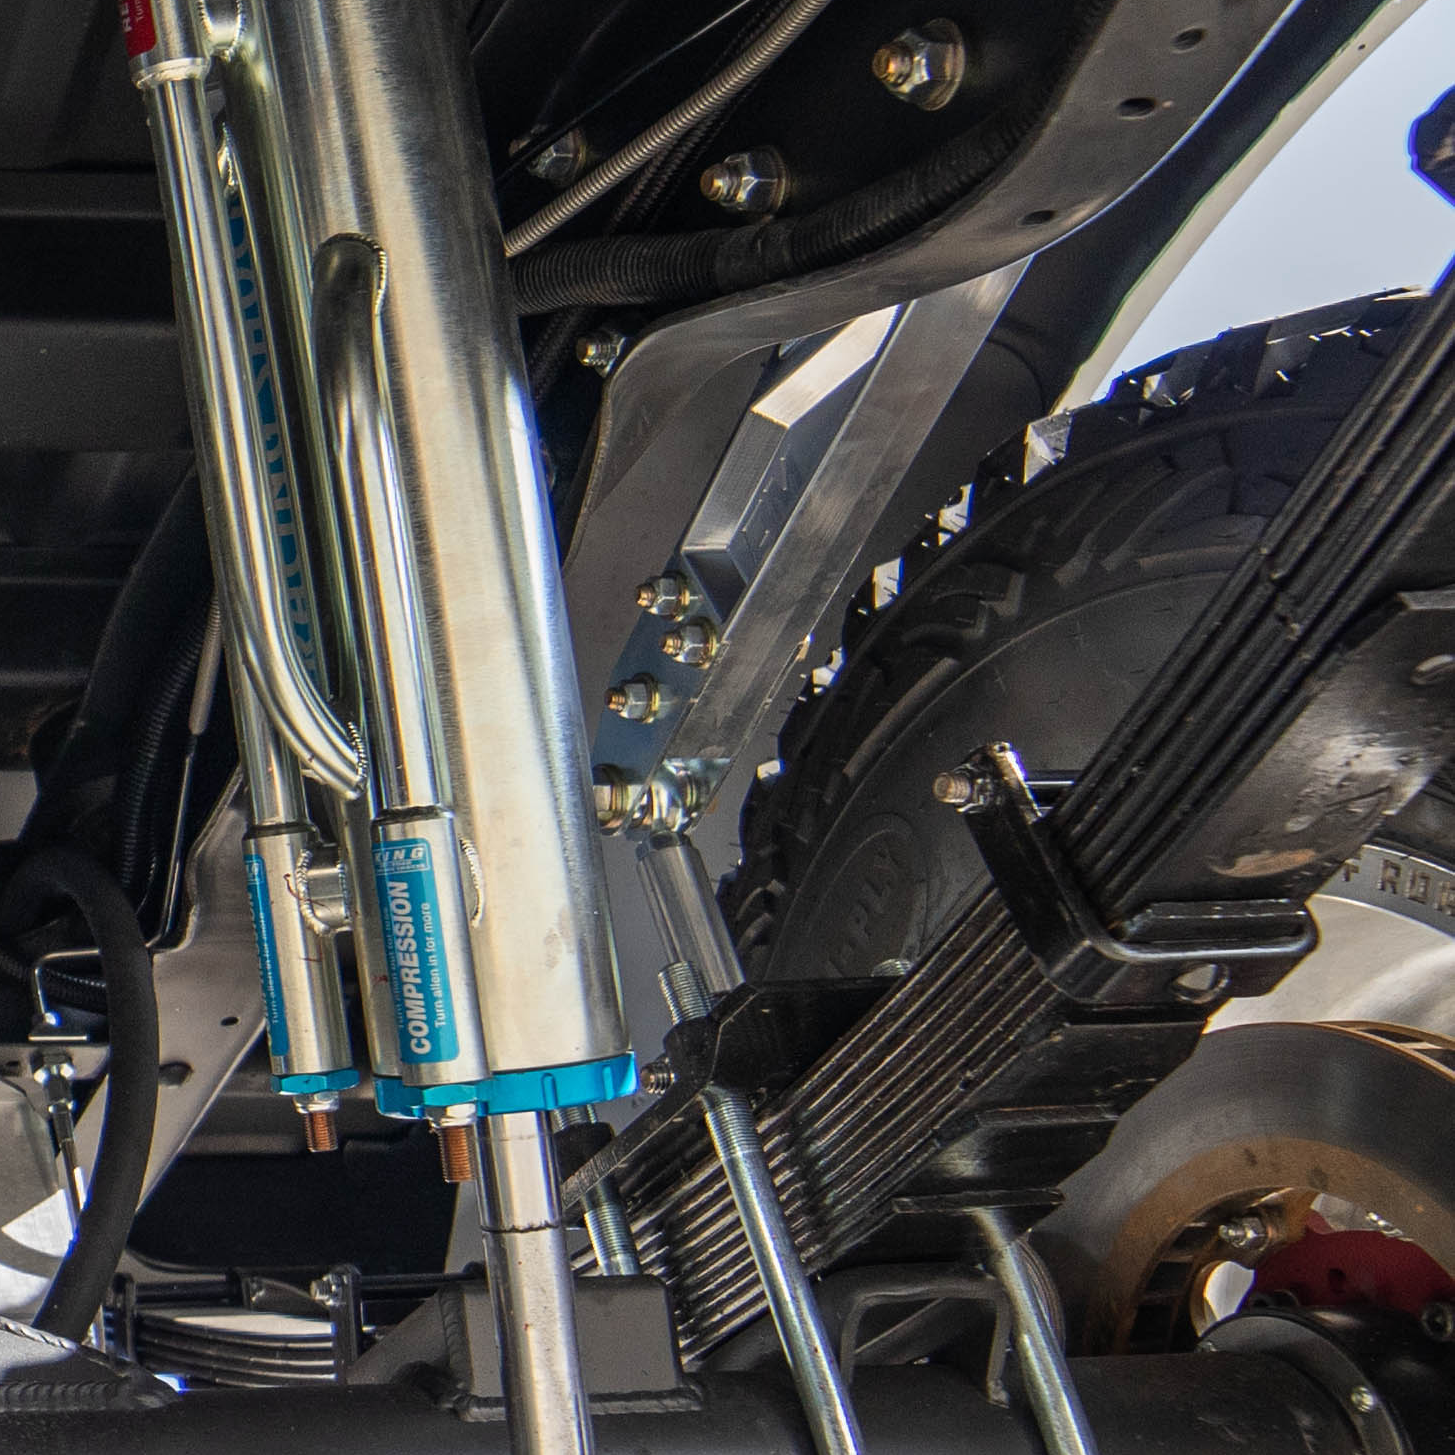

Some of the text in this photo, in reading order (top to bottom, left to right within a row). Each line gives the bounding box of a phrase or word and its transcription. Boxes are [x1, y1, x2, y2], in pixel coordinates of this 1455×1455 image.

[387, 880, 431, 1055] COMPRESSION
[421, 902, 446, 1028] Turn allen in for more
